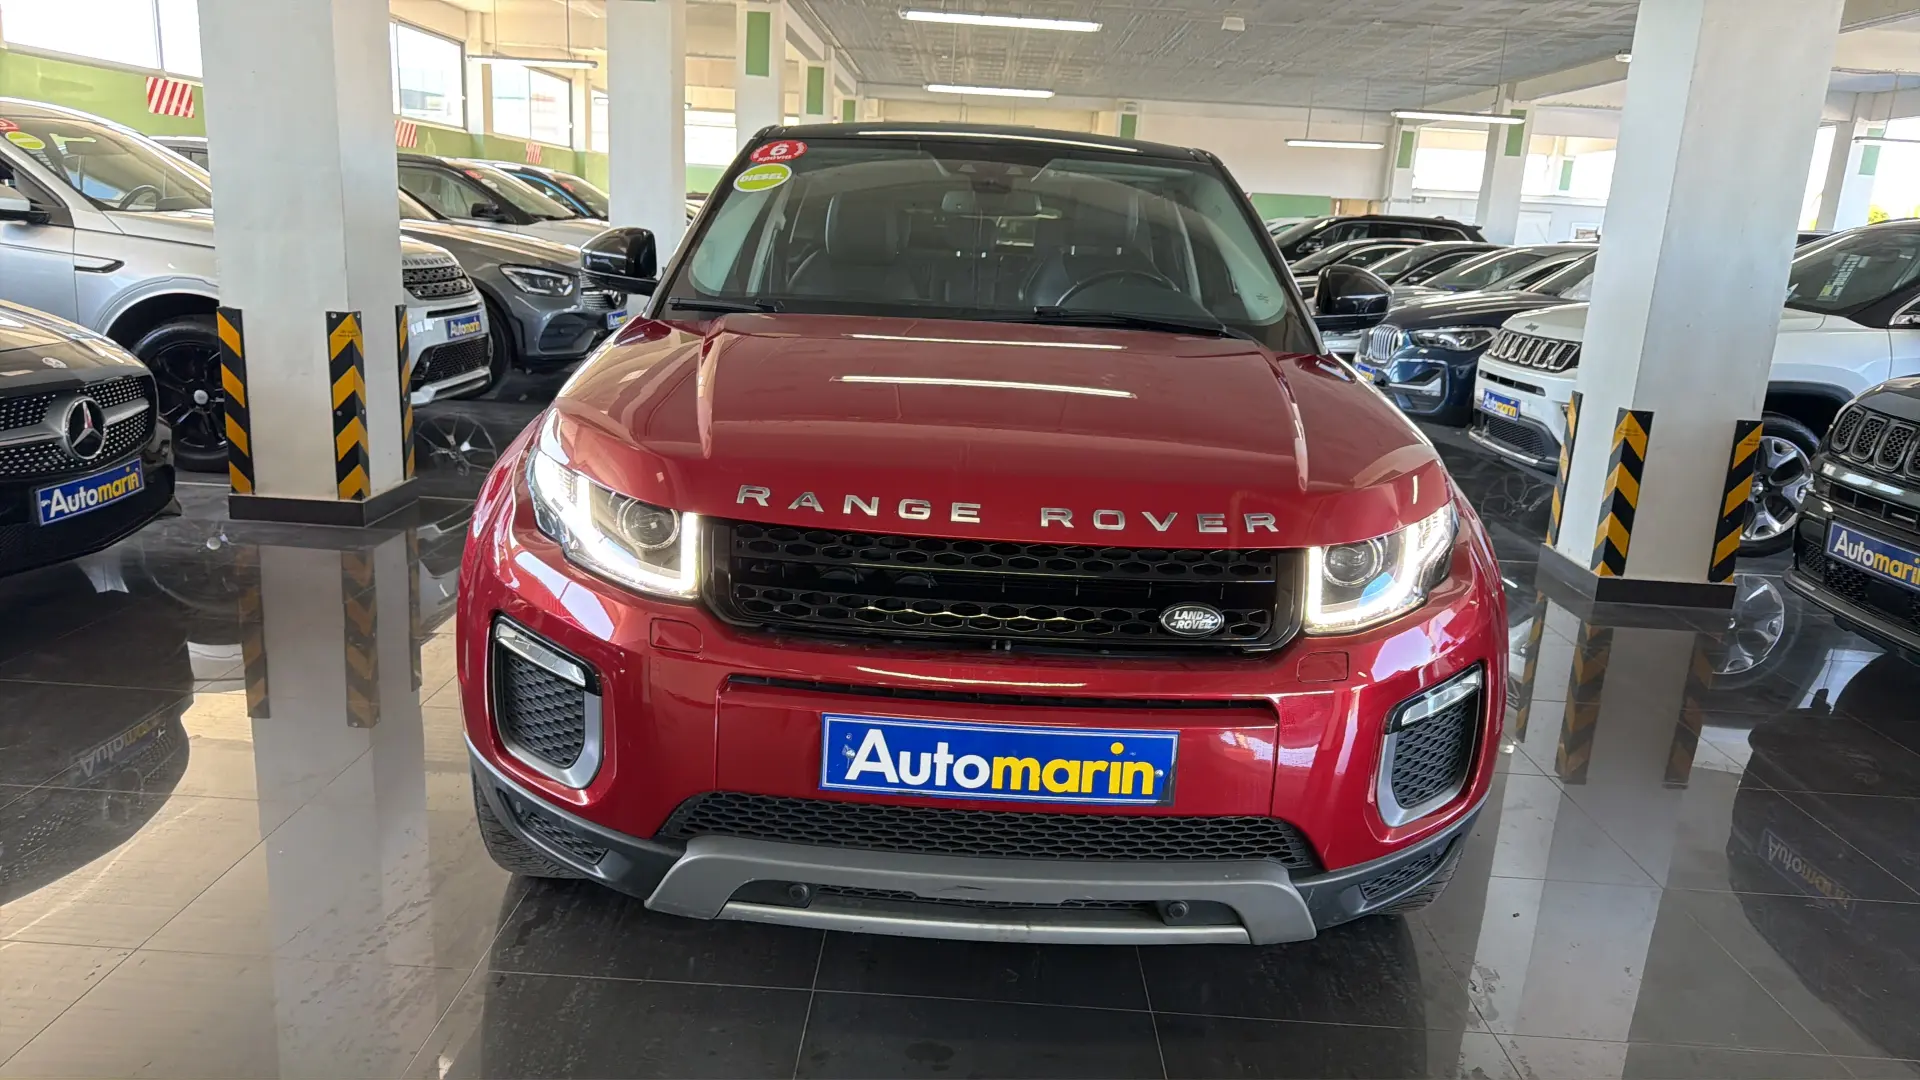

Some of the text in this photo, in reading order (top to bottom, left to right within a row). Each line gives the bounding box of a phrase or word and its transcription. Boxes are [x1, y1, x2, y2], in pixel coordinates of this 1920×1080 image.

[769, 142, 789, 156] 6
[739, 172, 785, 183] DIESEL
[49, 466, 140, 518] Automarin
[736, 484, 1280, 534] RANGE ROVER
[1173, 610, 1204, 620] LAND
[844, 728, 1155, 796] Automarin
